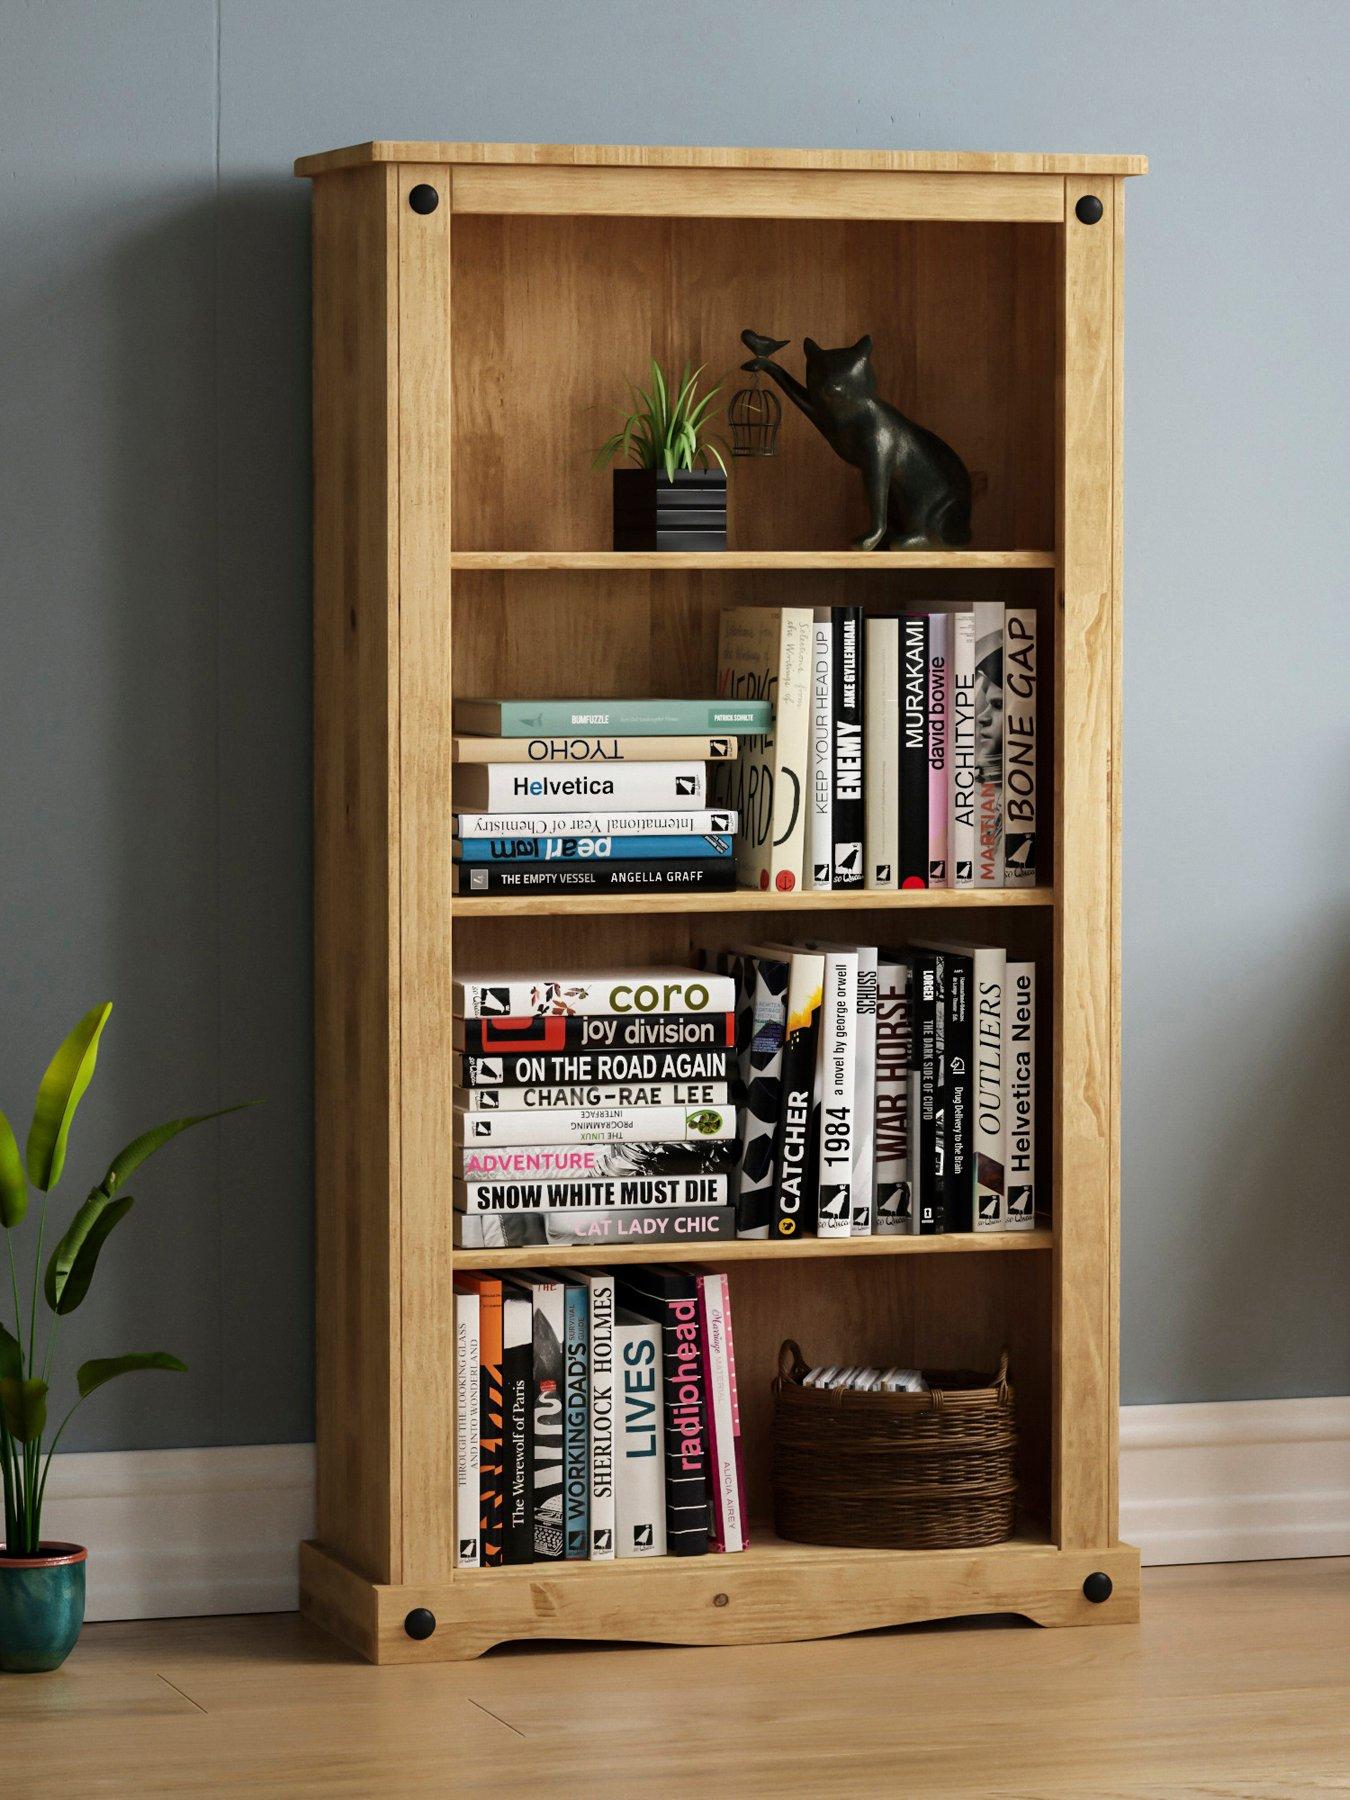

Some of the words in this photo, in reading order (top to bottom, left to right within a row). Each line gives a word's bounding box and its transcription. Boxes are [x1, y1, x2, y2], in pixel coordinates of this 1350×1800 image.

[816, 631, 829, 655] UP
[844, 619, 855, 682] GYLLENHAAL
[1006, 617, 1037, 698] GAP
[816, 660, 829, 710] HEAD
[844, 683, 855, 708] JAKE
[905, 621, 924, 748] MURAKAMI
[929, 656, 944, 714] bowie
[571, 715, 609, 725] BUMFUZZLE
[714, 714, 733, 722] PATRICK
[528, 740, 624, 760] TYCHO
[816, 714, 829, 764] YOUR
[929, 721, 944, 770] david
[955, 673, 975, 827] ARCHITYPE
[836, 721, 861, 800] ENEMY
[1007, 715, 1035, 822] BONE
[514, 776, 614, 795] Helvetica
[816, 770, 828, 814] KEEP
[474, 818, 547, 835] Chemistry
[551, 820, 566, 834] of
[570, 819, 602, 833] Year
[607, 818, 694, 832] International
[980, 783, 996, 880] MARTIAN
[490, 838, 539, 858] jam
[544, 837, 611, 860] pearl
[501, 874, 521, 884] THE
[523, 874, 557, 884] EMPTY
[560, 873, 596, 883] VESSEL
[611, 871, 662, 883] ANGELLA
[666, 871, 703, 881] GRAFF
[836, 964, 847, 997] orwell
[857, 971, 877, 1014] SCHUSS
[923, 970, 934, 1001] LORGEN
[609, 984, 709, 1012] coro
[1011, 976, 1031, 1041] Neue
[581, 1016, 617, 1045] joy
[624, 1018, 714, 1044] division
[836, 1001, 848, 1037] george
[876, 984, 908, 1081] HORSE
[923, 1020, 934, 1035] THE
[833, 1041, 847, 1053] by
[923, 1038, 934, 1060] DARK
[979, 982, 1001, 1135] OUTLIERS
[516, 1057, 545, 1082] ON
[552, 1056, 591, 1081] THE
[598, 1055, 657, 1080] ROAD
[661, 1053, 726, 1078] AGAIN
[833, 1057, 845, 1086] novel
[923, 1062, 934, 1080] SIDE
[523, 1085, 661, 1107] CHANG-RAE
[674, 1085, 714, 1104] LEE
[923, 1083, 934, 1093] OF
[953, 1086, 964, 1104] Drug
[581, 1110, 623, 1119] INTERFACE
[923, 1096, 934, 1120] CUPID
[953, 1105, 964, 1133] Delivery
[1011, 1051, 1030, 1171] Helvetica
[570, 1120, 633, 1130] PROGRAMMING
[607, 1132, 623, 1140] THE
[824, 1106, 850, 1168] 1984
[876, 1094, 908, 1163] WAR
[954, 1134, 963, 1142] to
[466, 1152, 595, 1173] ADVENTURE
[779, 1091, 809, 1213] CATCHER
[954, 1143, 963, 1155] the
[954, 1156, 963, 1174] Brain
[477, 1185, 542, 1210] SNOW
[547, 1182, 615, 1207] WHITE
[621, 1180, 680, 1205] MUST
[685, 1179, 718, 1202] DIE
[574, 1220, 612, 1236] CAT
[618, 1217, 669, 1234] LADY
[674, 1215, 720, 1232] CHIC
[458, 1323, 467, 1357] GLASS
[593, 1287, 612, 1374] HOLMES
[711, 1308, 722, 1353] Marriage
[458, 1360, 467, 1409] LOOKING
[470, 1339, 478, 1416] WONDERLAND
[568, 1343, 586, 1408] DAD'S
[668, 1301, 702, 1471] radiohead
[512, 1380, 525, 1411] Paris
[623, 1339, 657, 1459] LIVES
[458, 1413, 467, 1432] THE
[470, 1419, 478, 1446] INTO
[512, 1415, 525, 1430] of
[593, 1386, 612, 1498] SHERLOCK
[458, 1434, 467, 1487] THROUGH
[470, 1450, 478, 1470] AND
[512, 1432, 525, 1496] Werewolf
[568, 1412, 586, 1520] WORKING
[724, 1461, 732, 1495] ALICIA
[512, 1499, 525, 1528] The
[727, 1499, 736, 1529] AIREY
